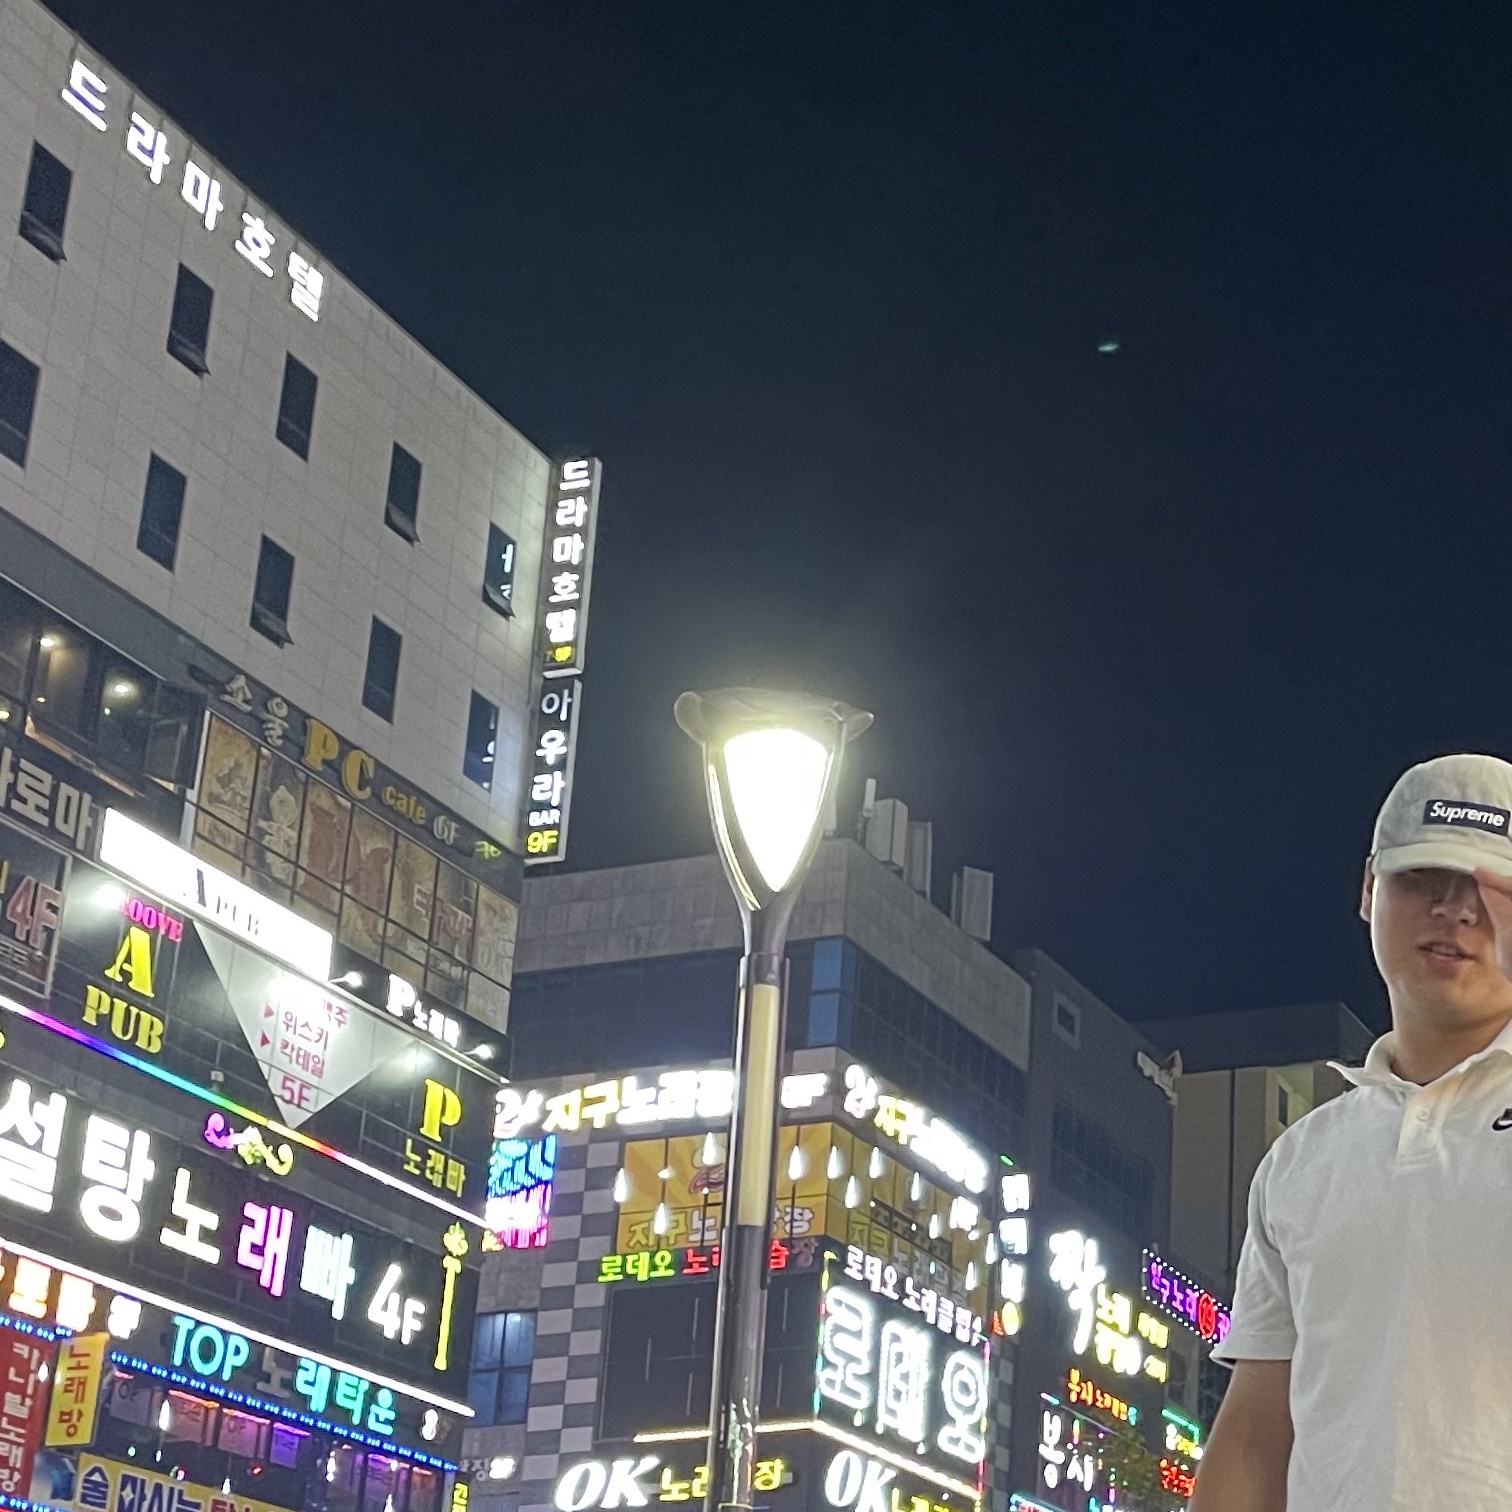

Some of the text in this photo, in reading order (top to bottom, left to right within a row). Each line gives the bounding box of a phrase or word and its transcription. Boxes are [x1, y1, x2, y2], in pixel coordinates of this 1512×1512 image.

[61, 58, 324, 322] 드라마호텔
[544, 459, 591, 644] 드라마호텔
[303, 717, 375, 800] PC
[530, 687, 572, 807] 아우라
[527, 830, 559, 854] 9F
[528, 808, 561, 827] BAR
[1429, 801, 1506, 827] Supreme
[6, 875, 64, 949] 4F
[104, 925, 156, 998] A
[83, 983, 164, 1056] PUB
[281, 1009, 329, 1050] 위스키
[280, 1037, 326, 1079] 칵테일
[280, 1074, 313, 1109] 5F
[419, 1077, 463, 1142] P
[597, 1249, 676, 1283] 로데오
[843, 1243, 899, 1302] 로데오
[366, 1262, 427, 1345] 4F
[172, 1315, 251, 1382] TOP
[58, 1344, 91, 1439] 노래방
[80, 1464, 110, 1512] 술
